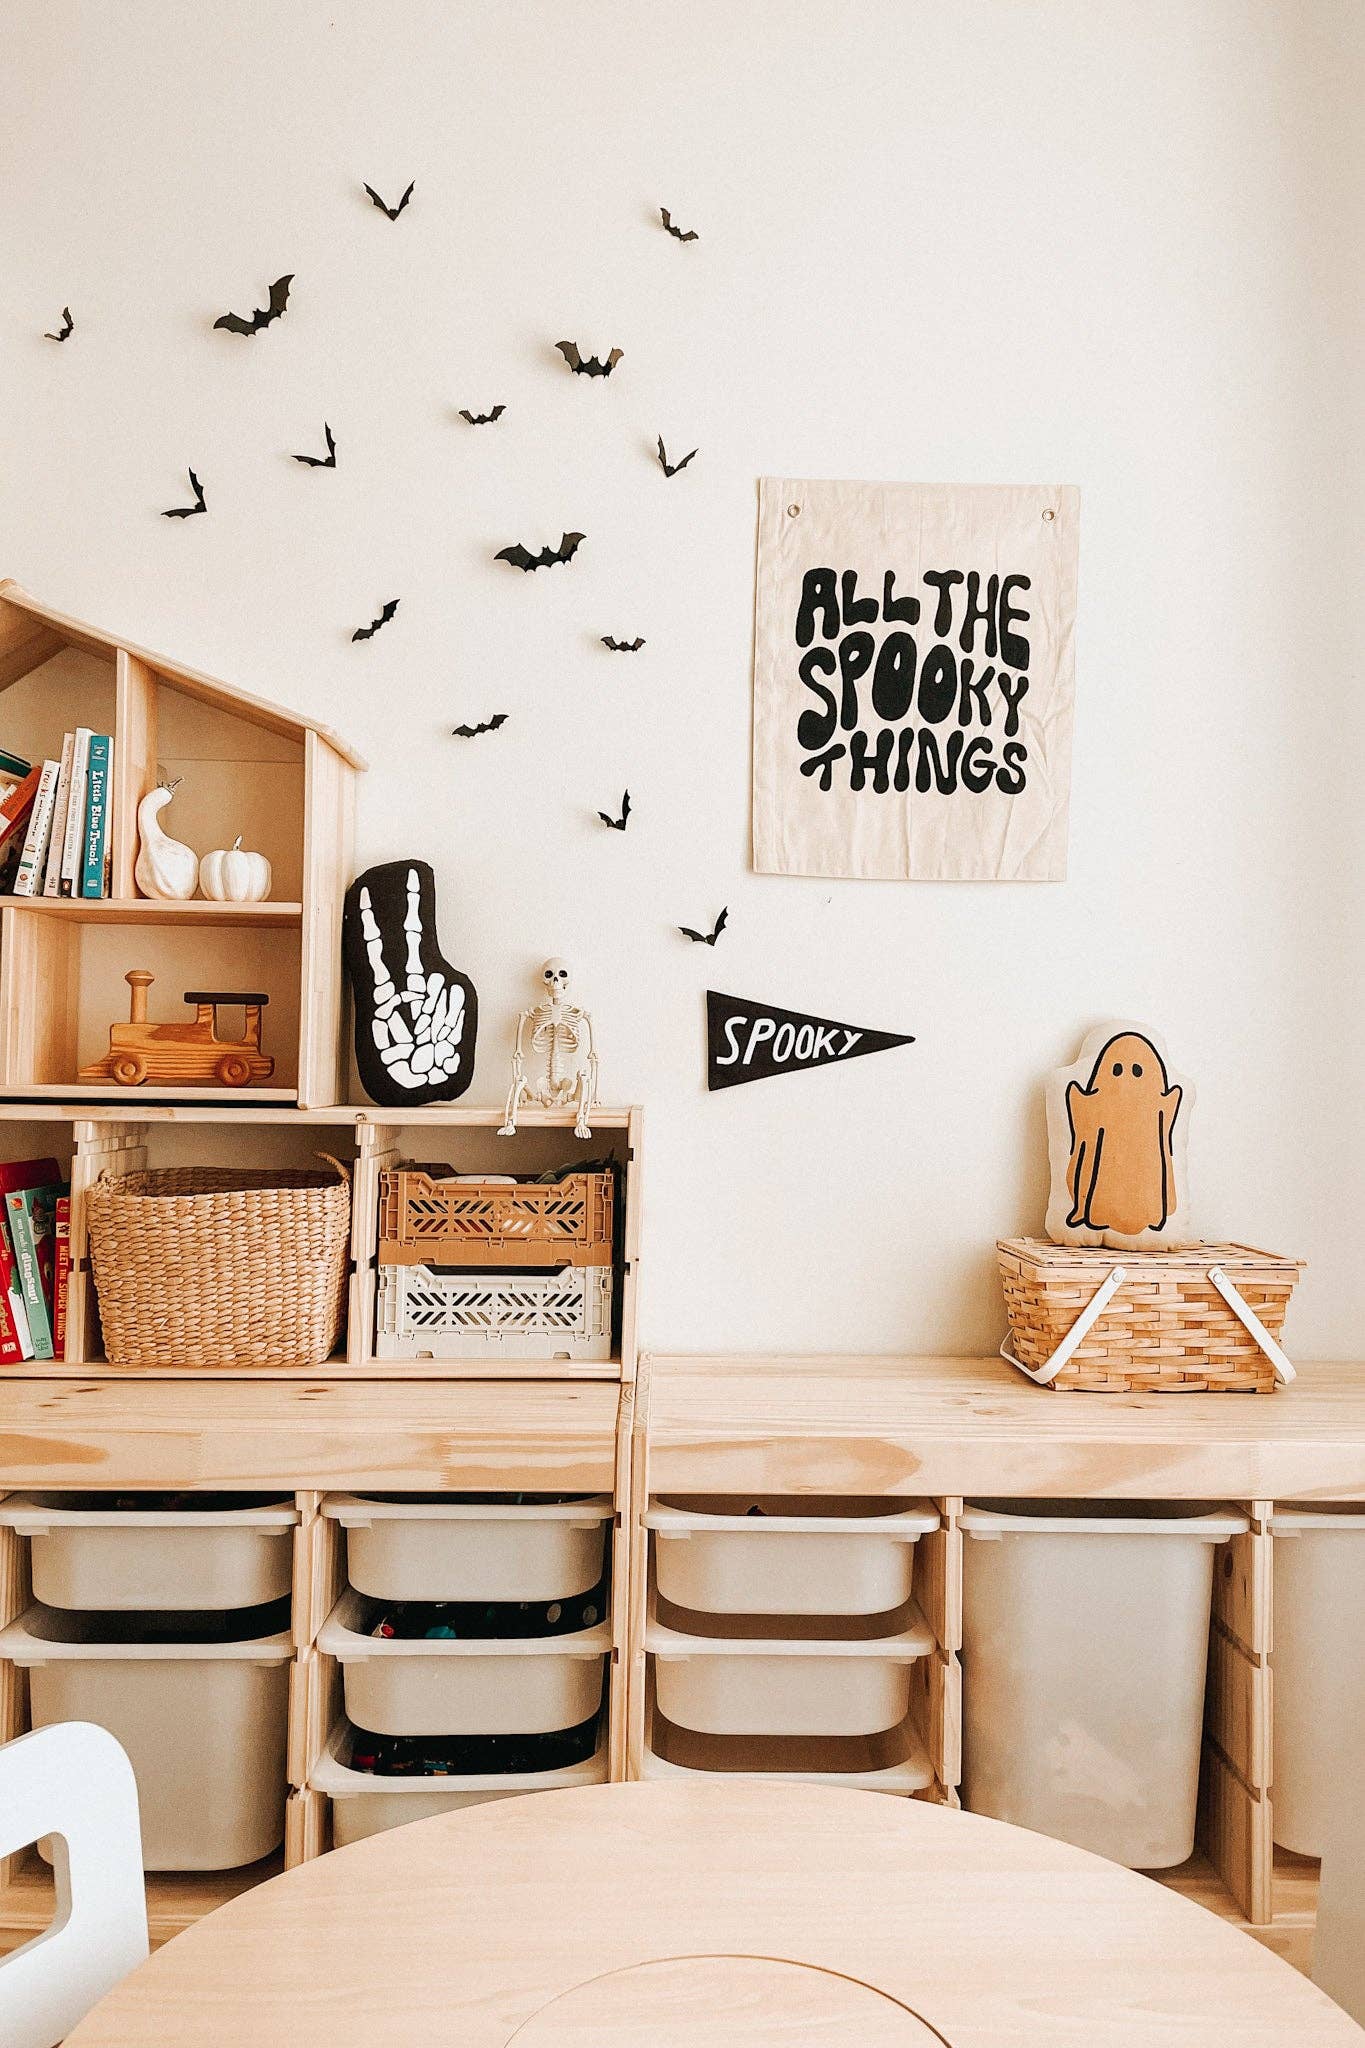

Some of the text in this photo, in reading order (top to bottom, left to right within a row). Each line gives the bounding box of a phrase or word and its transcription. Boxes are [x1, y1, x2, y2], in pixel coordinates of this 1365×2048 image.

[795, 567, 1032, 672] ALL THE
[797, 630, 1030, 751] SPOOKY
[799, 726, 1028, 796] THINGS
[92, 770, 104, 803] Little
[91, 804, 102, 830] Blue
[88, 830, 101, 866] Truck
[716, 1015, 864, 1066] SPOOKY
[59, 1245, 69, 1264] MEET
[59, 1282, 68, 1309] SUPER
[56, 1311, 67, 1340] WINGS
